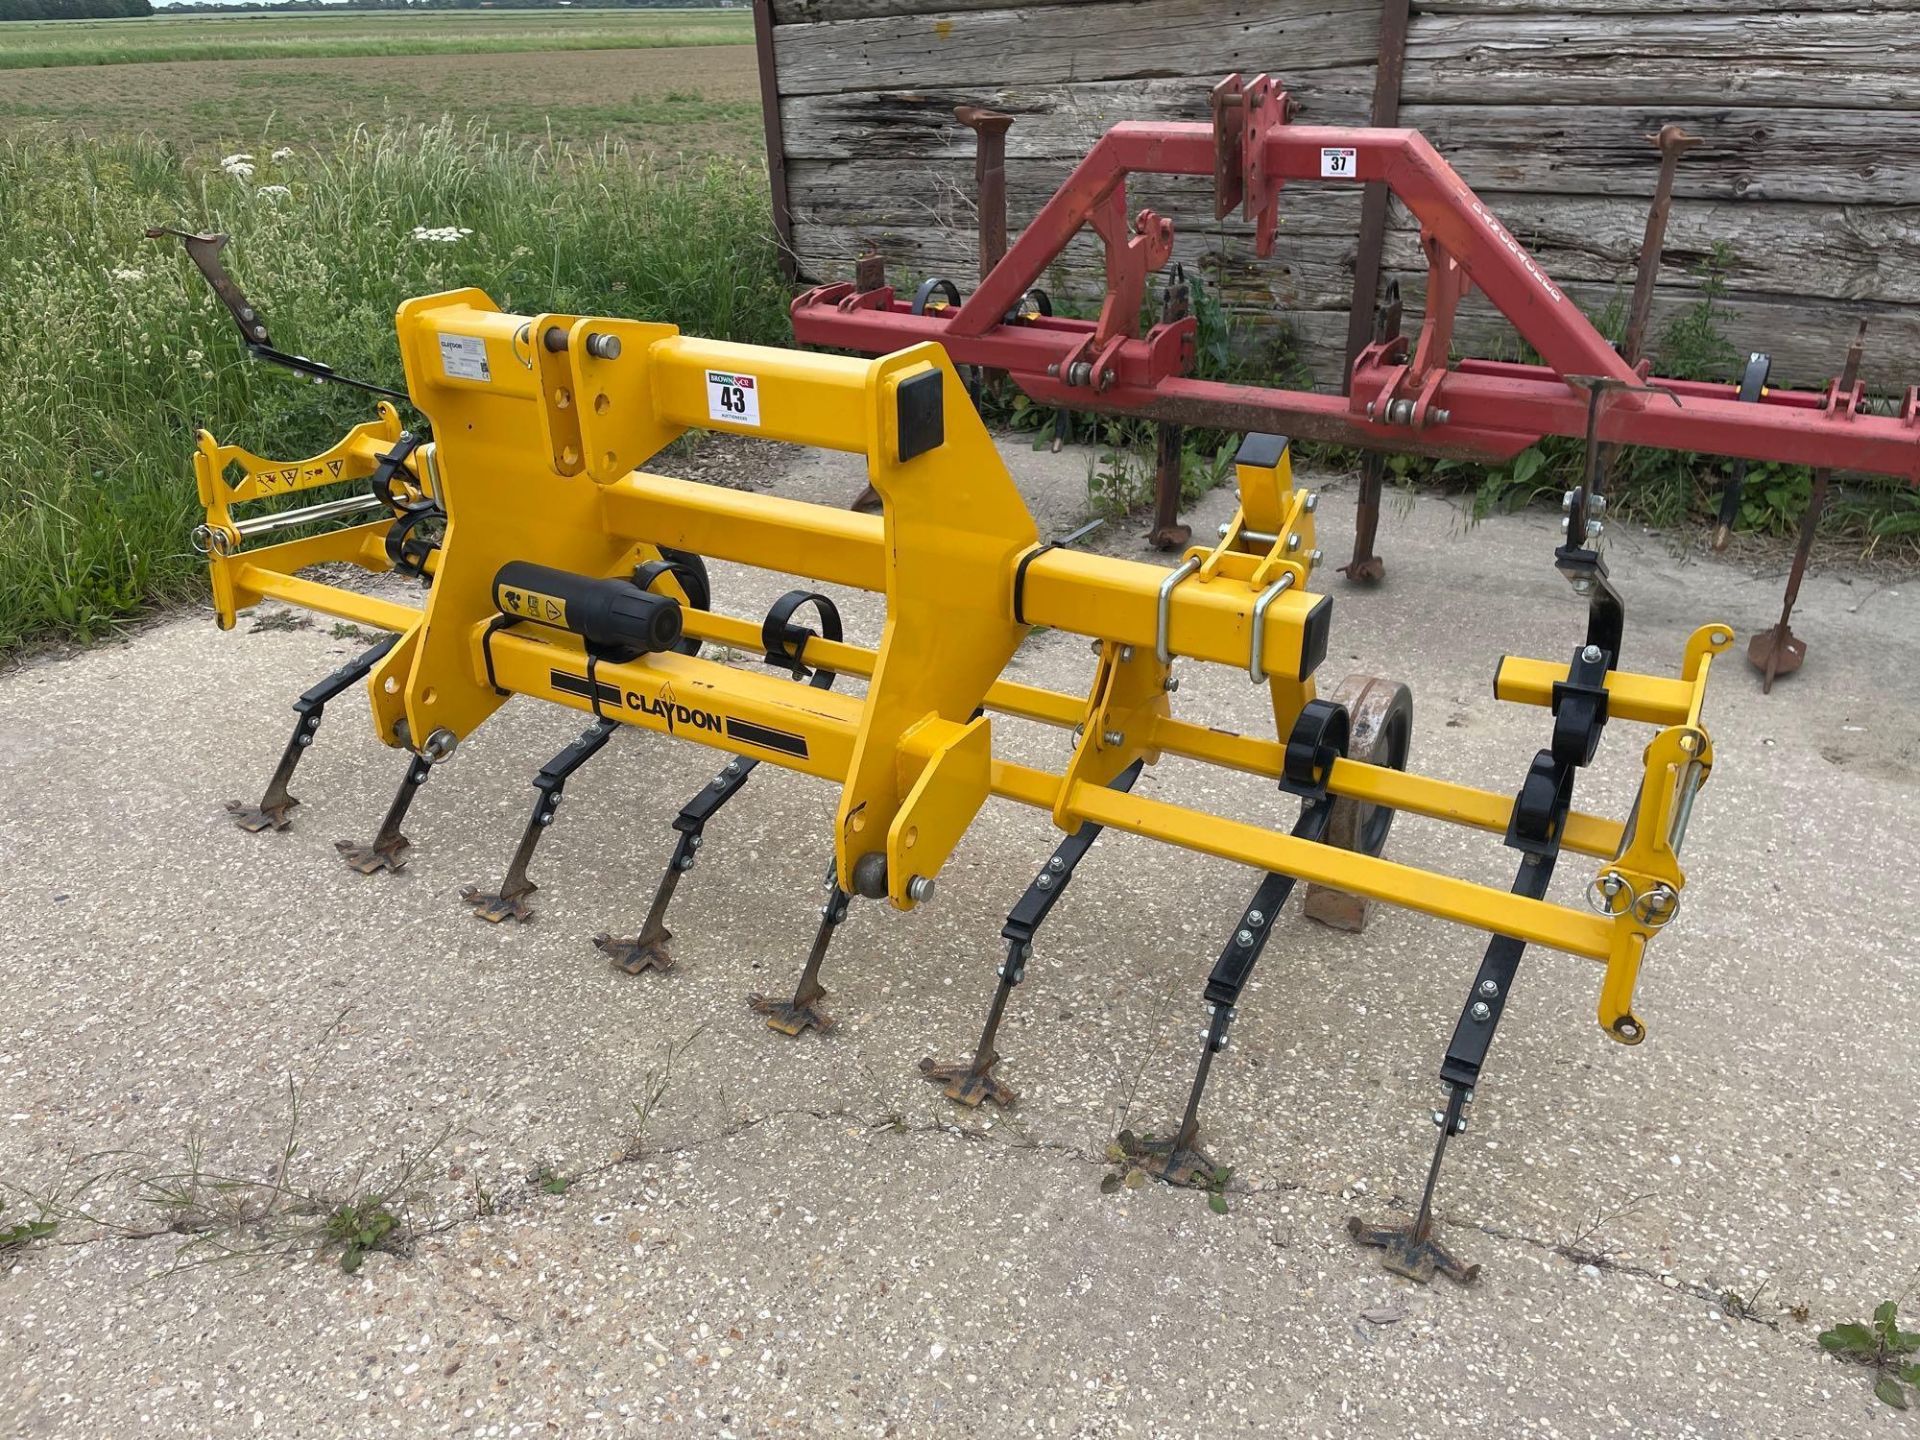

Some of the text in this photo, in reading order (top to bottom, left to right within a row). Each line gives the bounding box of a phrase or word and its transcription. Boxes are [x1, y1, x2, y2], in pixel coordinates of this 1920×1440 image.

[1331, 156, 1346, 171] 37
[721, 386, 745, 413] 43
[626, 691, 722, 734] CLAYDON
